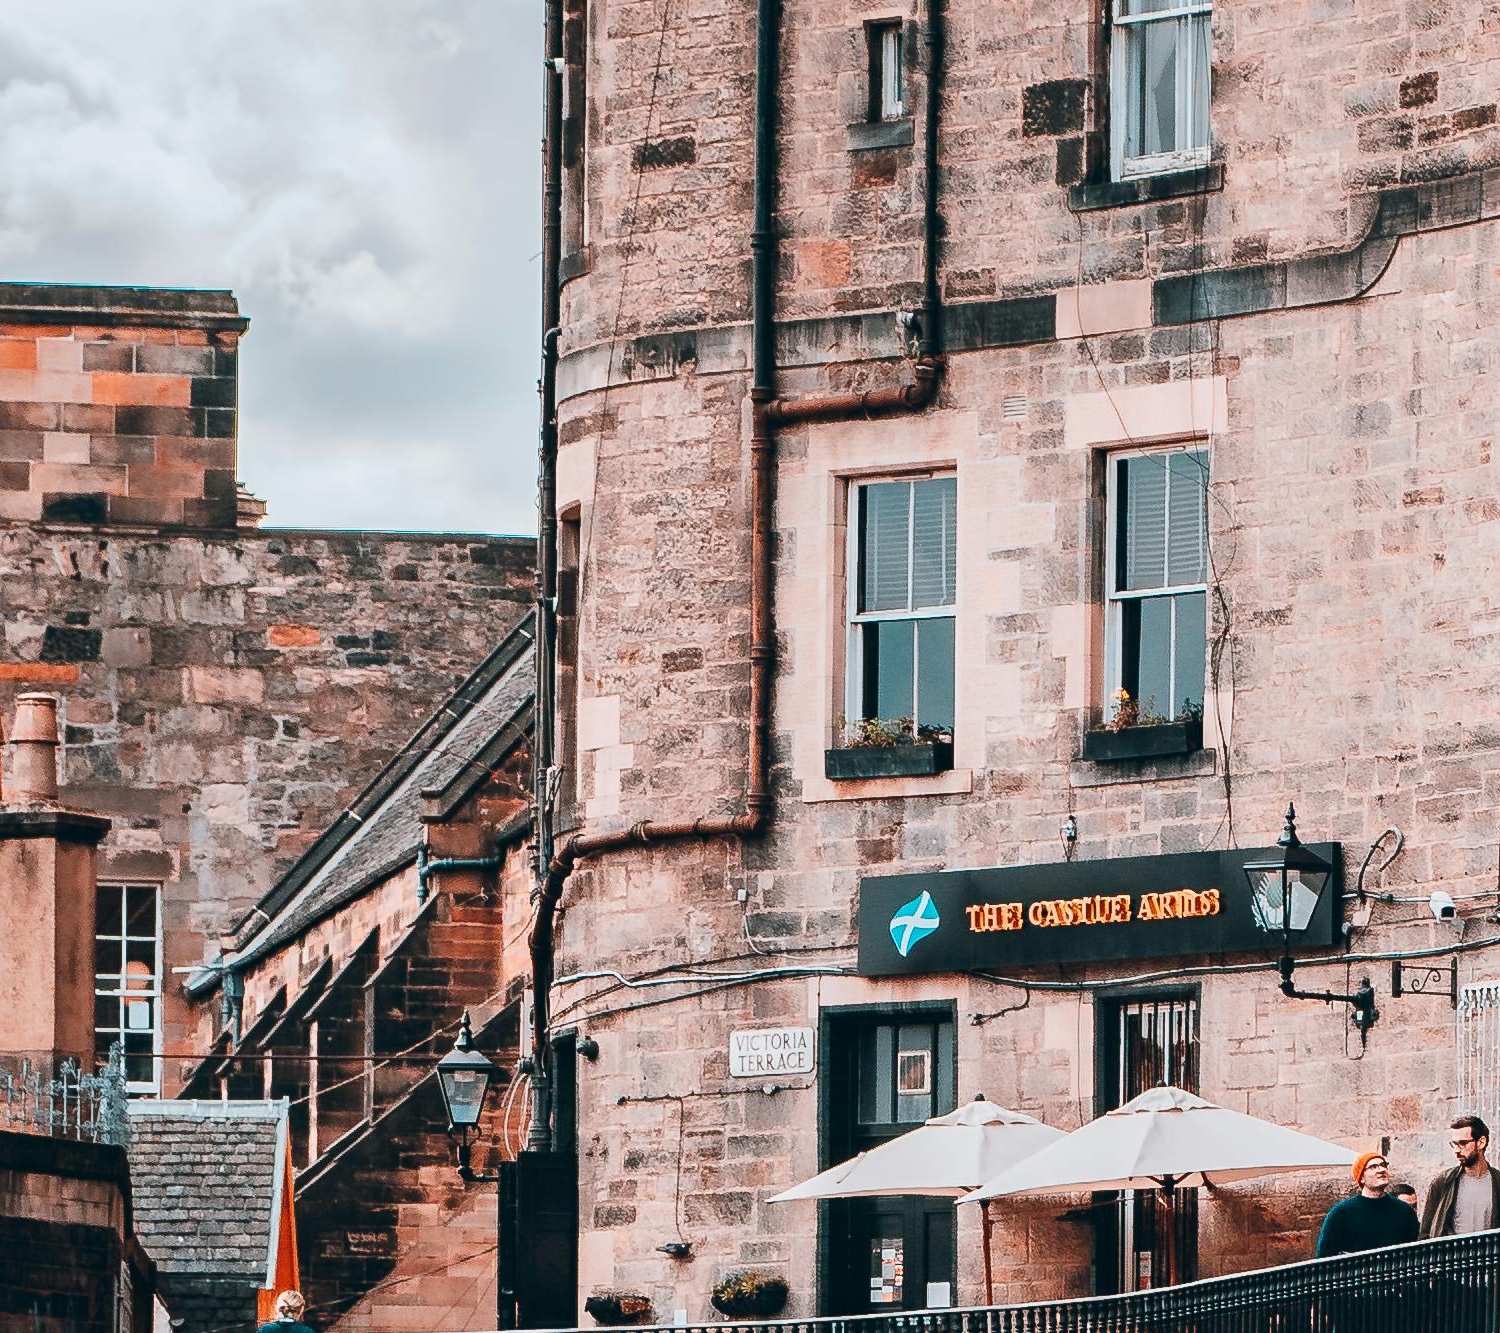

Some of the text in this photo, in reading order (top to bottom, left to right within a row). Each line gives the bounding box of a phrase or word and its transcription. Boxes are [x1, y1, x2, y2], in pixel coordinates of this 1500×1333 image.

[966, 902, 1022, 933] THE
[1029, 894, 1132, 928] CASTLE
[736, 1032, 807, 1051] VICTORIA
[738, 1052, 805, 1072] TERRACE
